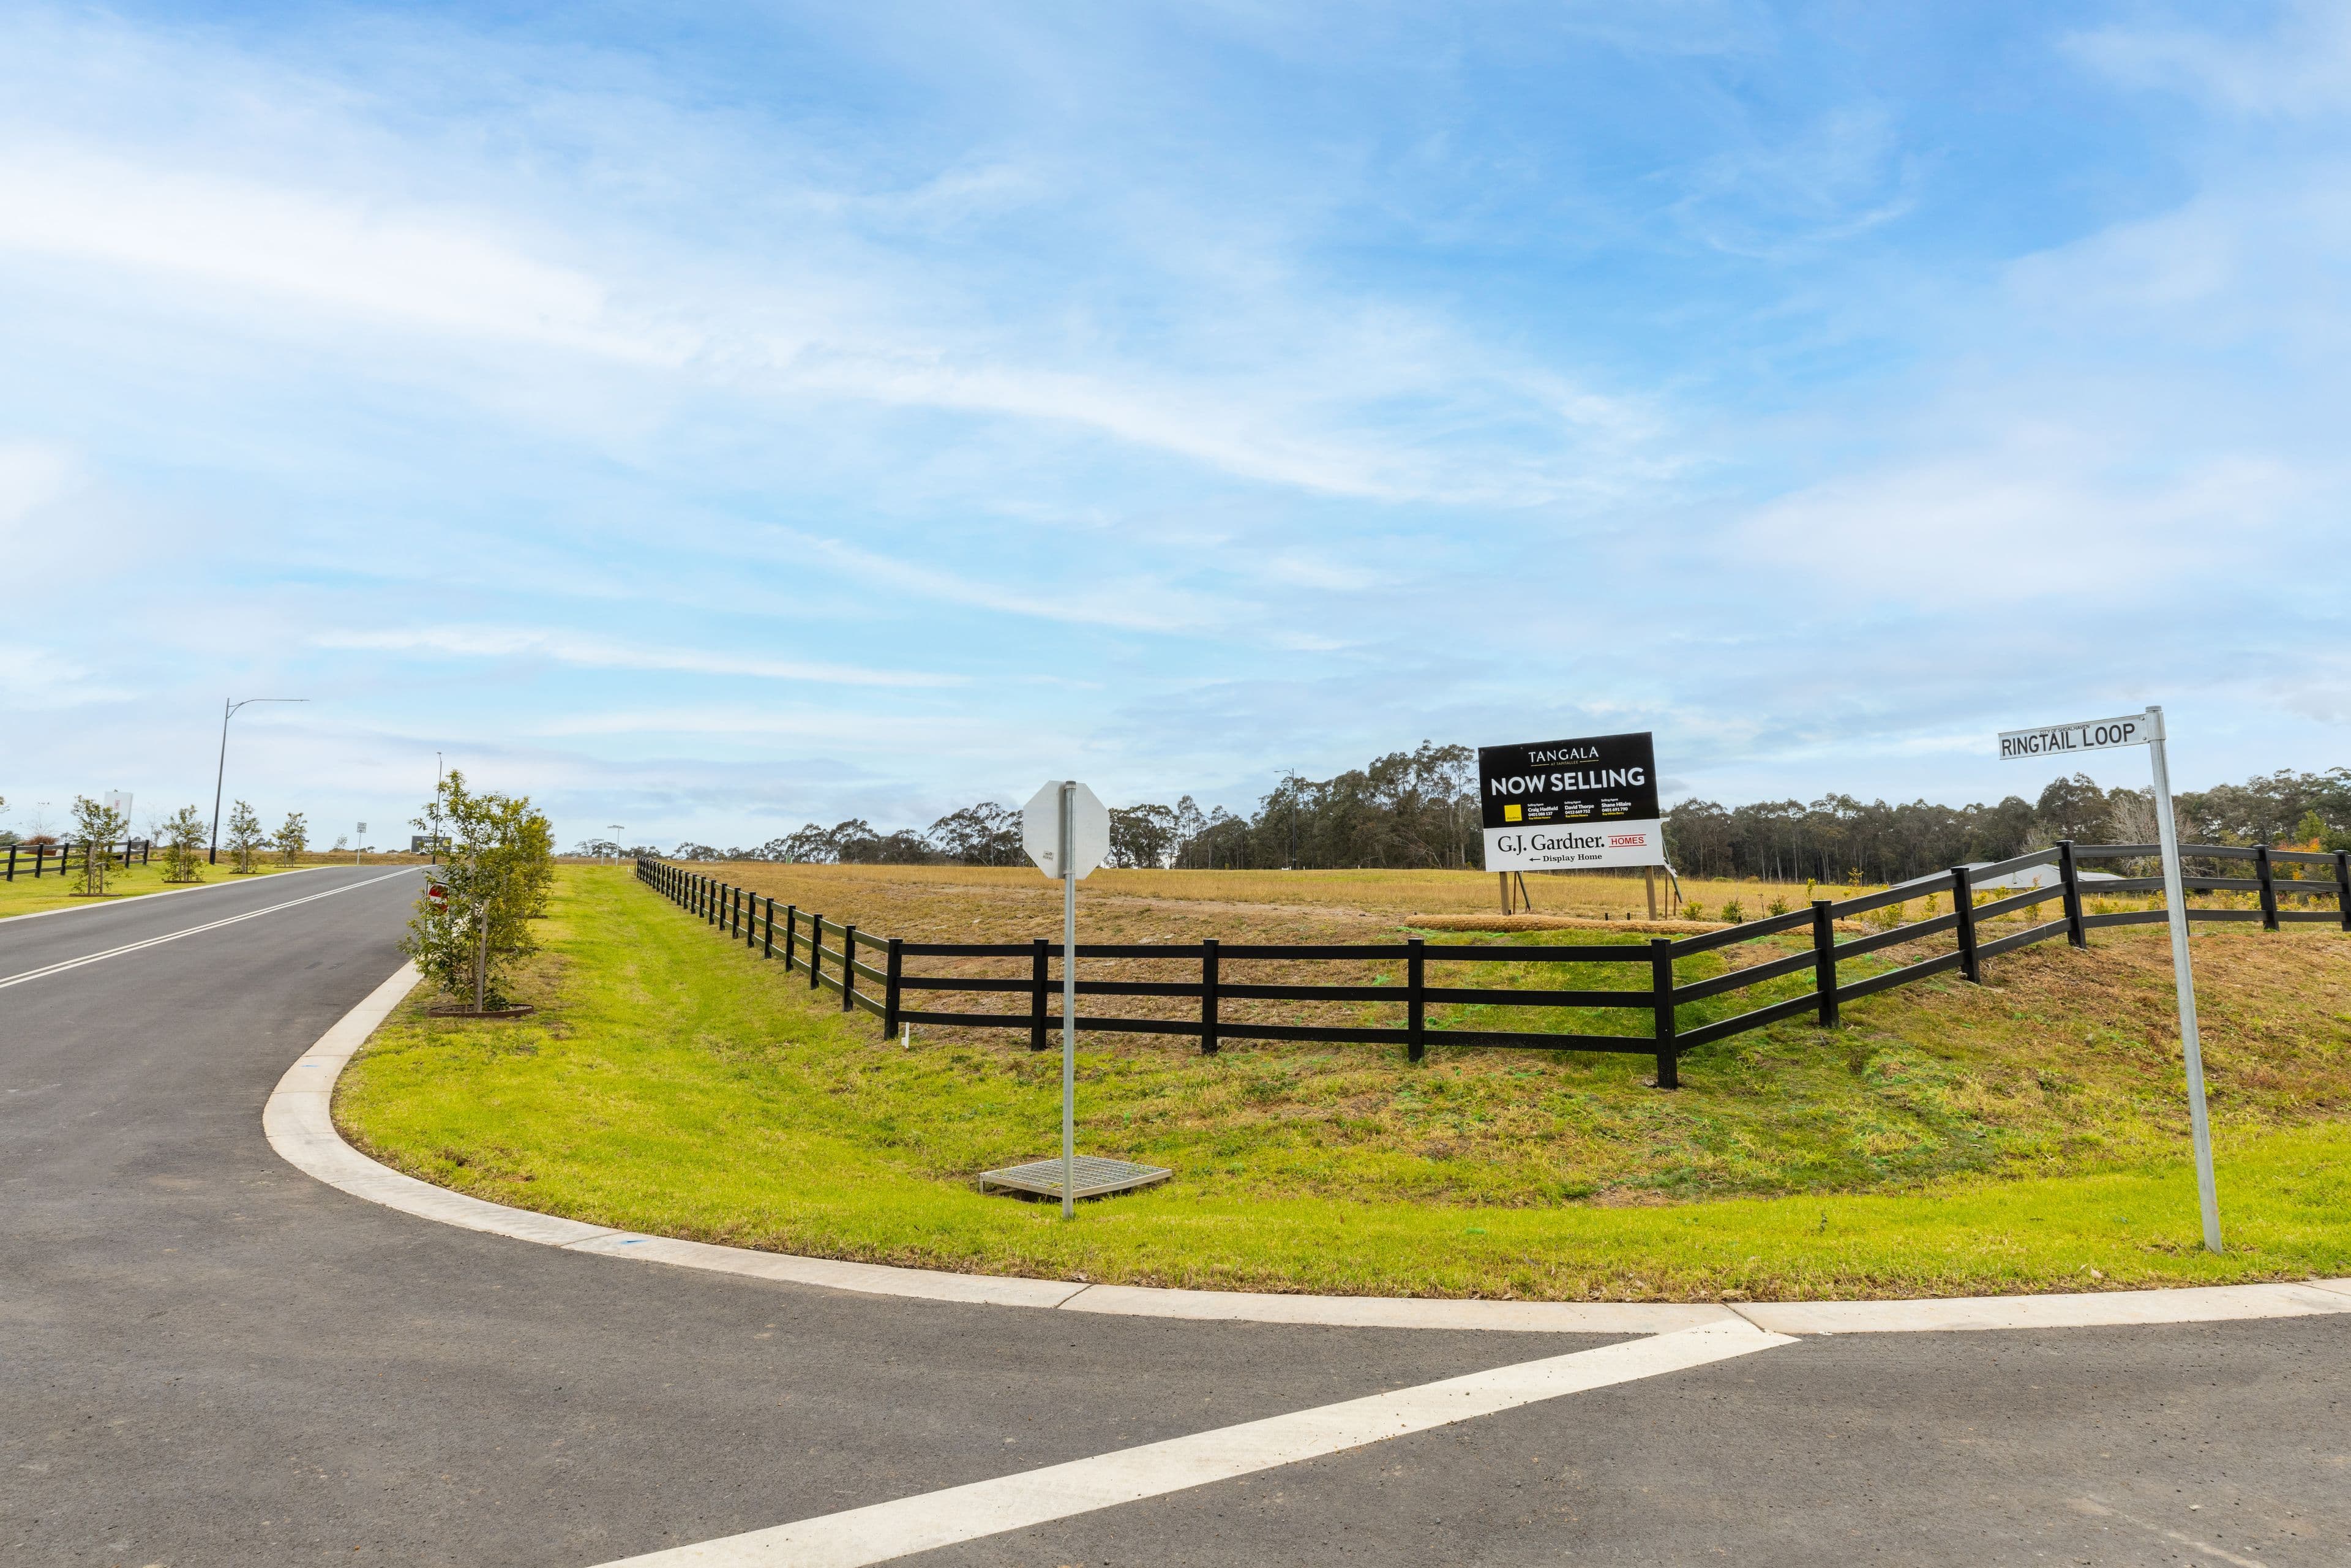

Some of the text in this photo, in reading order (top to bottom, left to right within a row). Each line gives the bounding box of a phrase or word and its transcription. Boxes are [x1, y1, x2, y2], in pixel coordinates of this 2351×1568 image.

[2001, 723, 2135, 756] RINGTAIL LOOP
[1528, 746, 1599, 763] TANGALA
[1491, 767, 1645, 795] NOW SELLING
[1498, 832, 1644, 855] G.J. Gardner. HOMES
